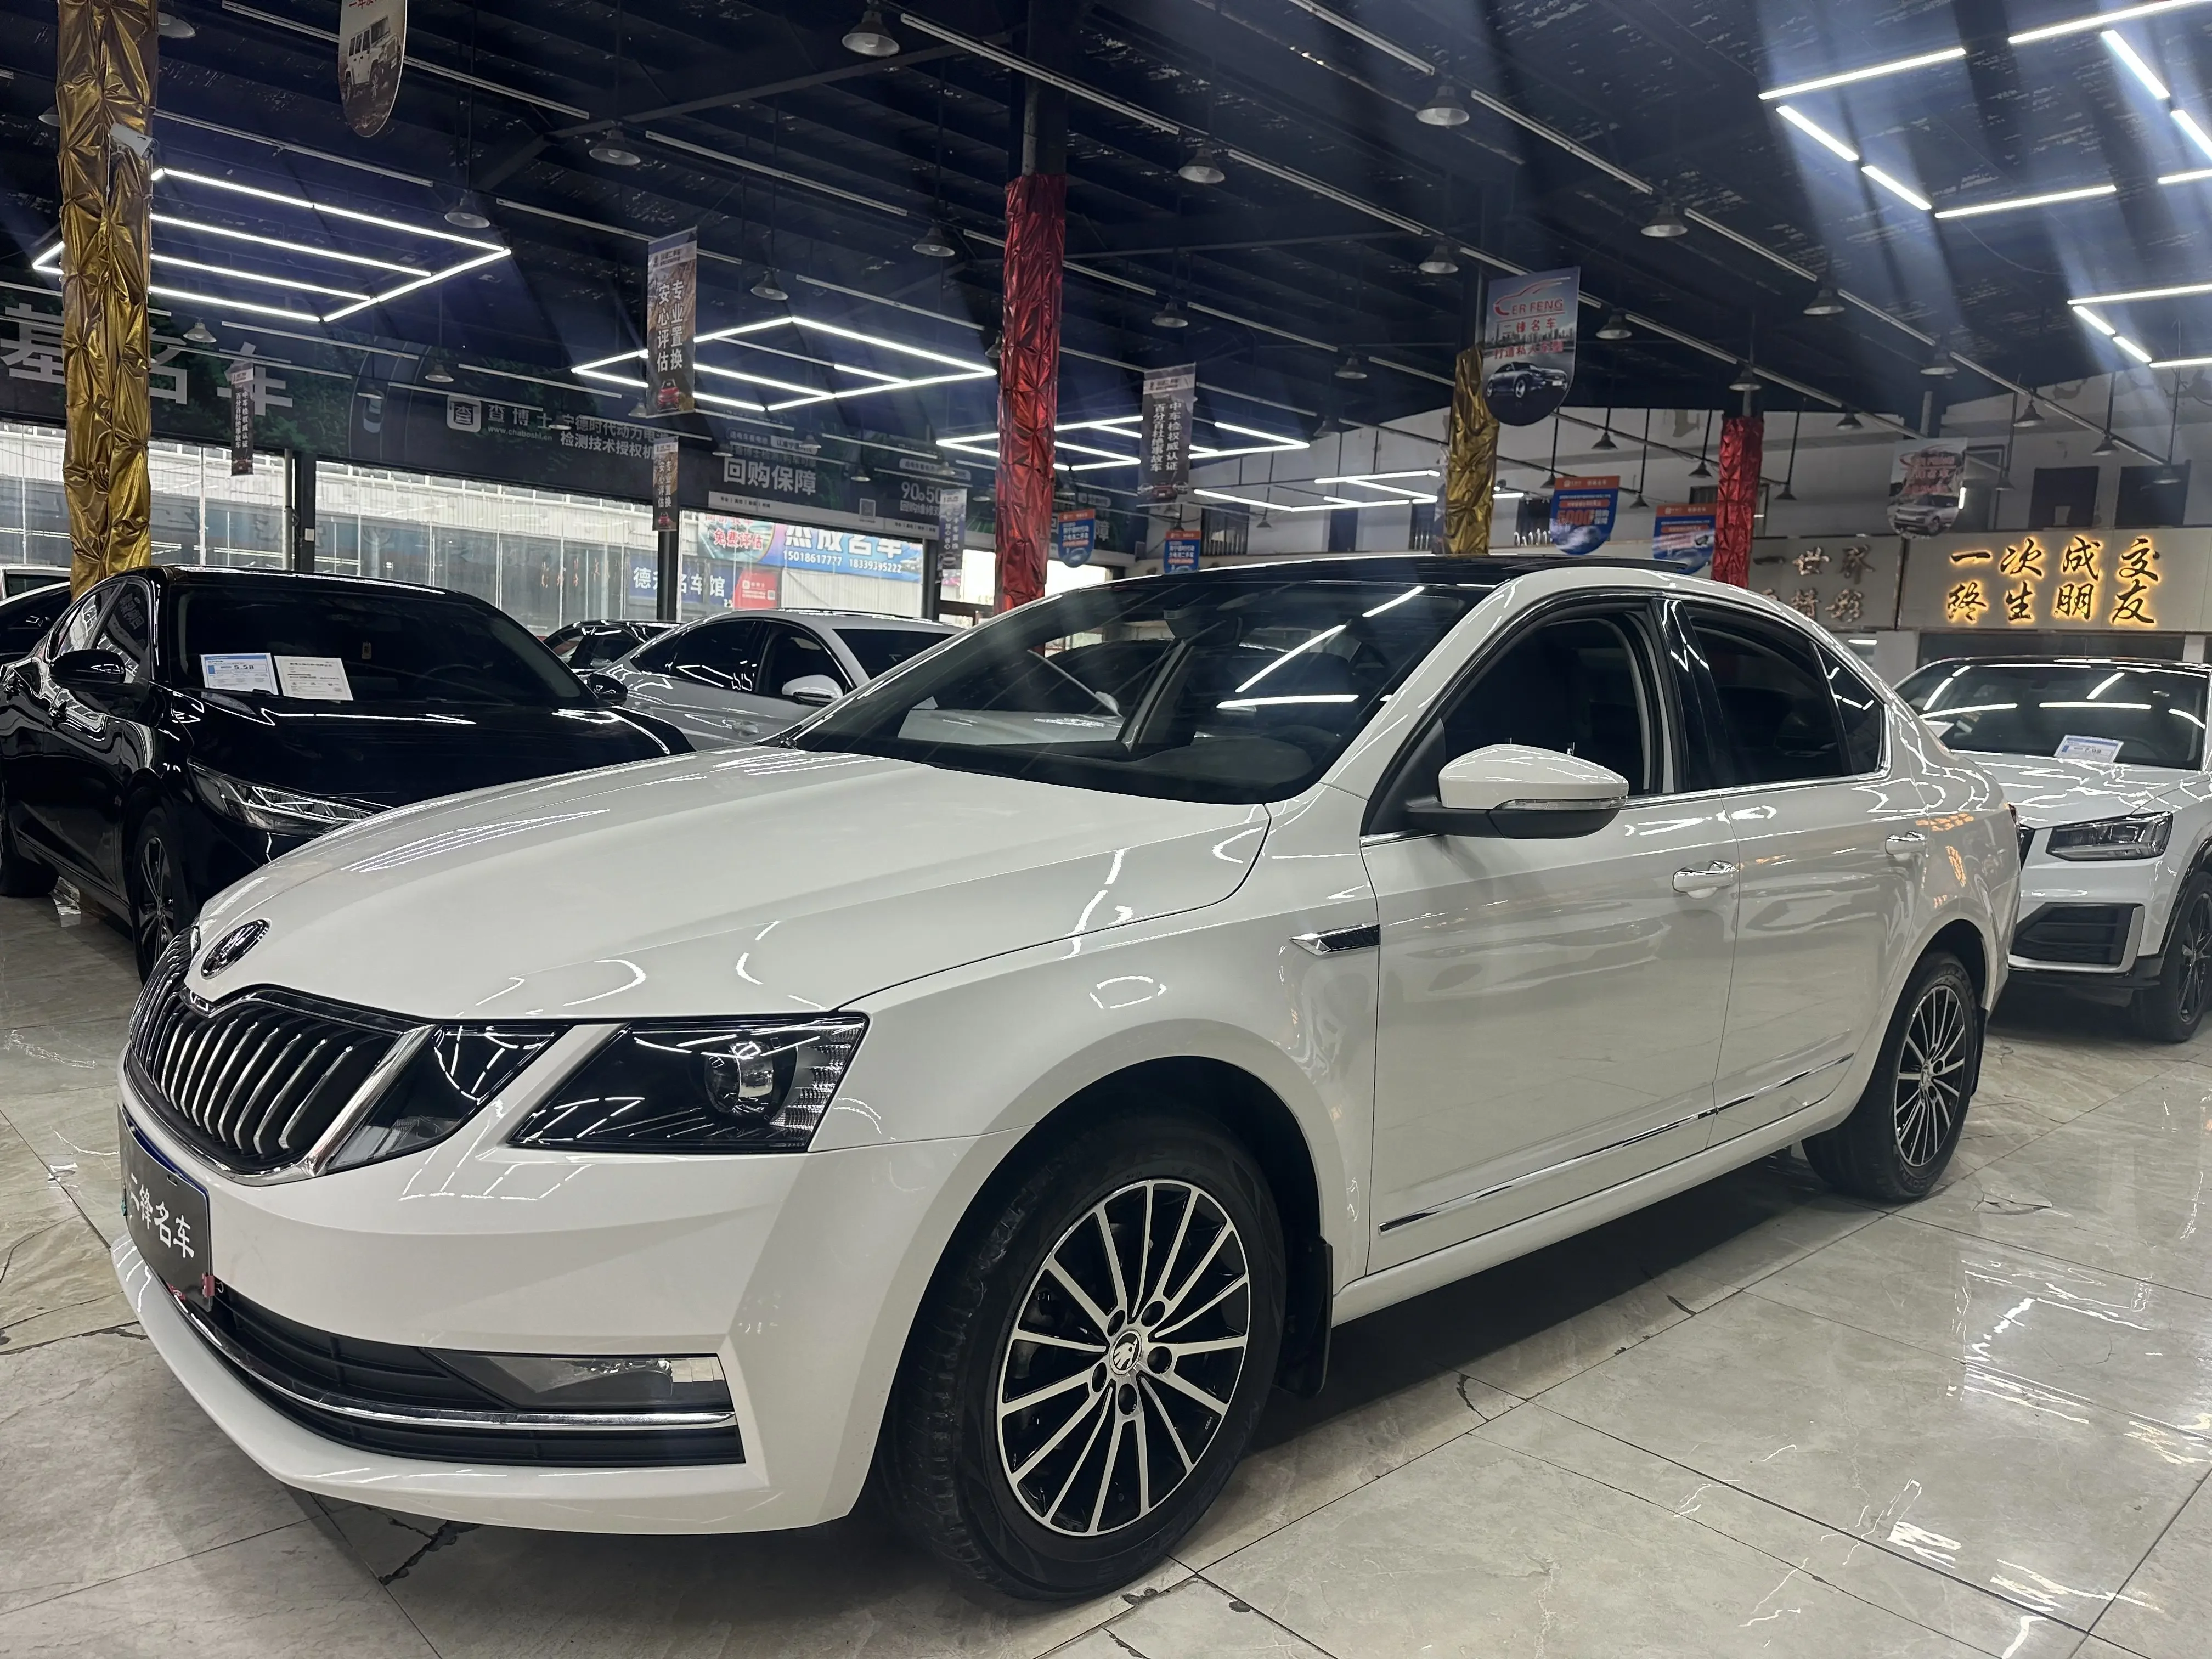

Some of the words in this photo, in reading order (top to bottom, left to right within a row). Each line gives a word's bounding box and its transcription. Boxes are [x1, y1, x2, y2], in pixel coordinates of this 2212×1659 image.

[670, 279, 684, 370] 专业置换
[1530, 298, 1562, 312] FENG
[657, 283, 670, 373] 安心评估
[488, 404, 552, 430] 查博士
[724, 456, 816, 495] 回购保障
[713, 527, 764, 551] 免费评估
[1948, 535, 2160, 582] 一次成交
[633, 566, 725, 597] 德车馆
[1946, 580, 2155, 625] 终生朋友
